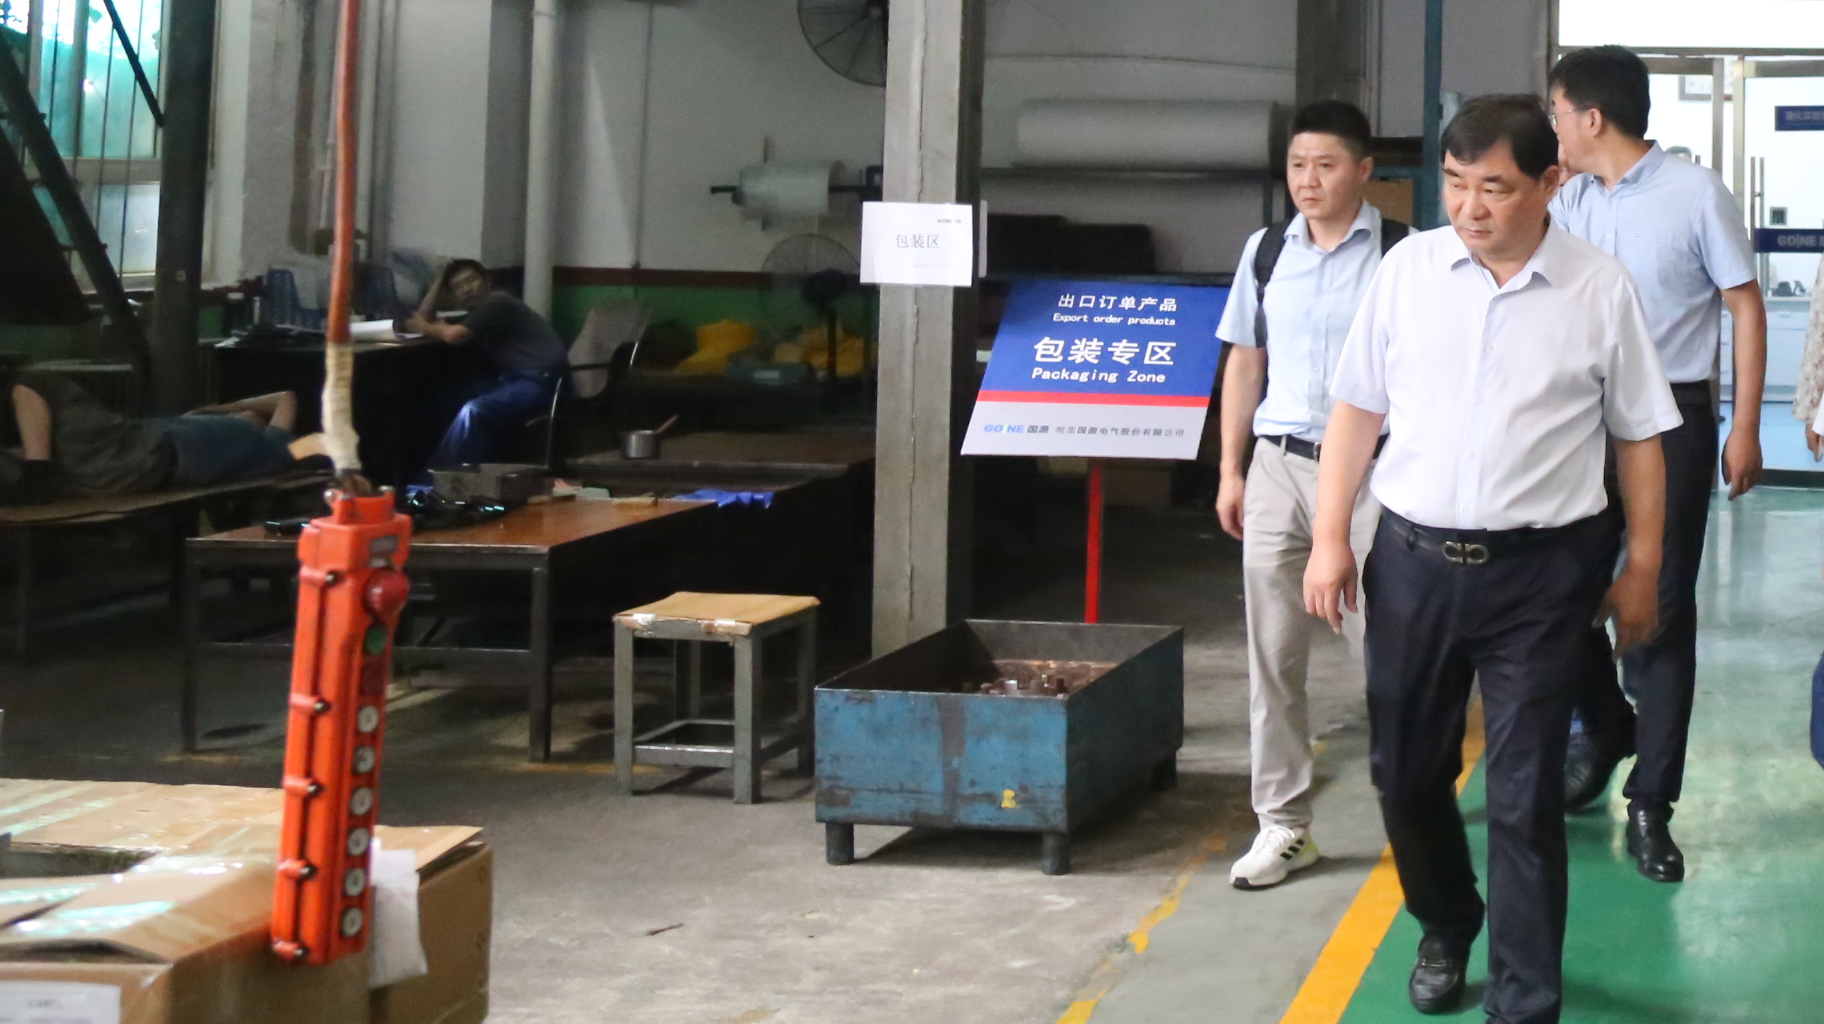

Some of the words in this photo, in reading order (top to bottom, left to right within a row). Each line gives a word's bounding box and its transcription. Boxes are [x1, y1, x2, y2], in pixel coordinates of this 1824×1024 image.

[895, 233, 941, 249] 包装区
[1058, 293, 1178, 312] 出口订单产品
[1053, 313, 1089, 323] Export
[1093, 315, 1124, 324] order
[1127, 316, 1176, 326] products
[1034, 336, 1177, 366] 包装专区
[1032, 367, 1119, 383] Packaging
[1127, 370, 1166, 383] Zone
